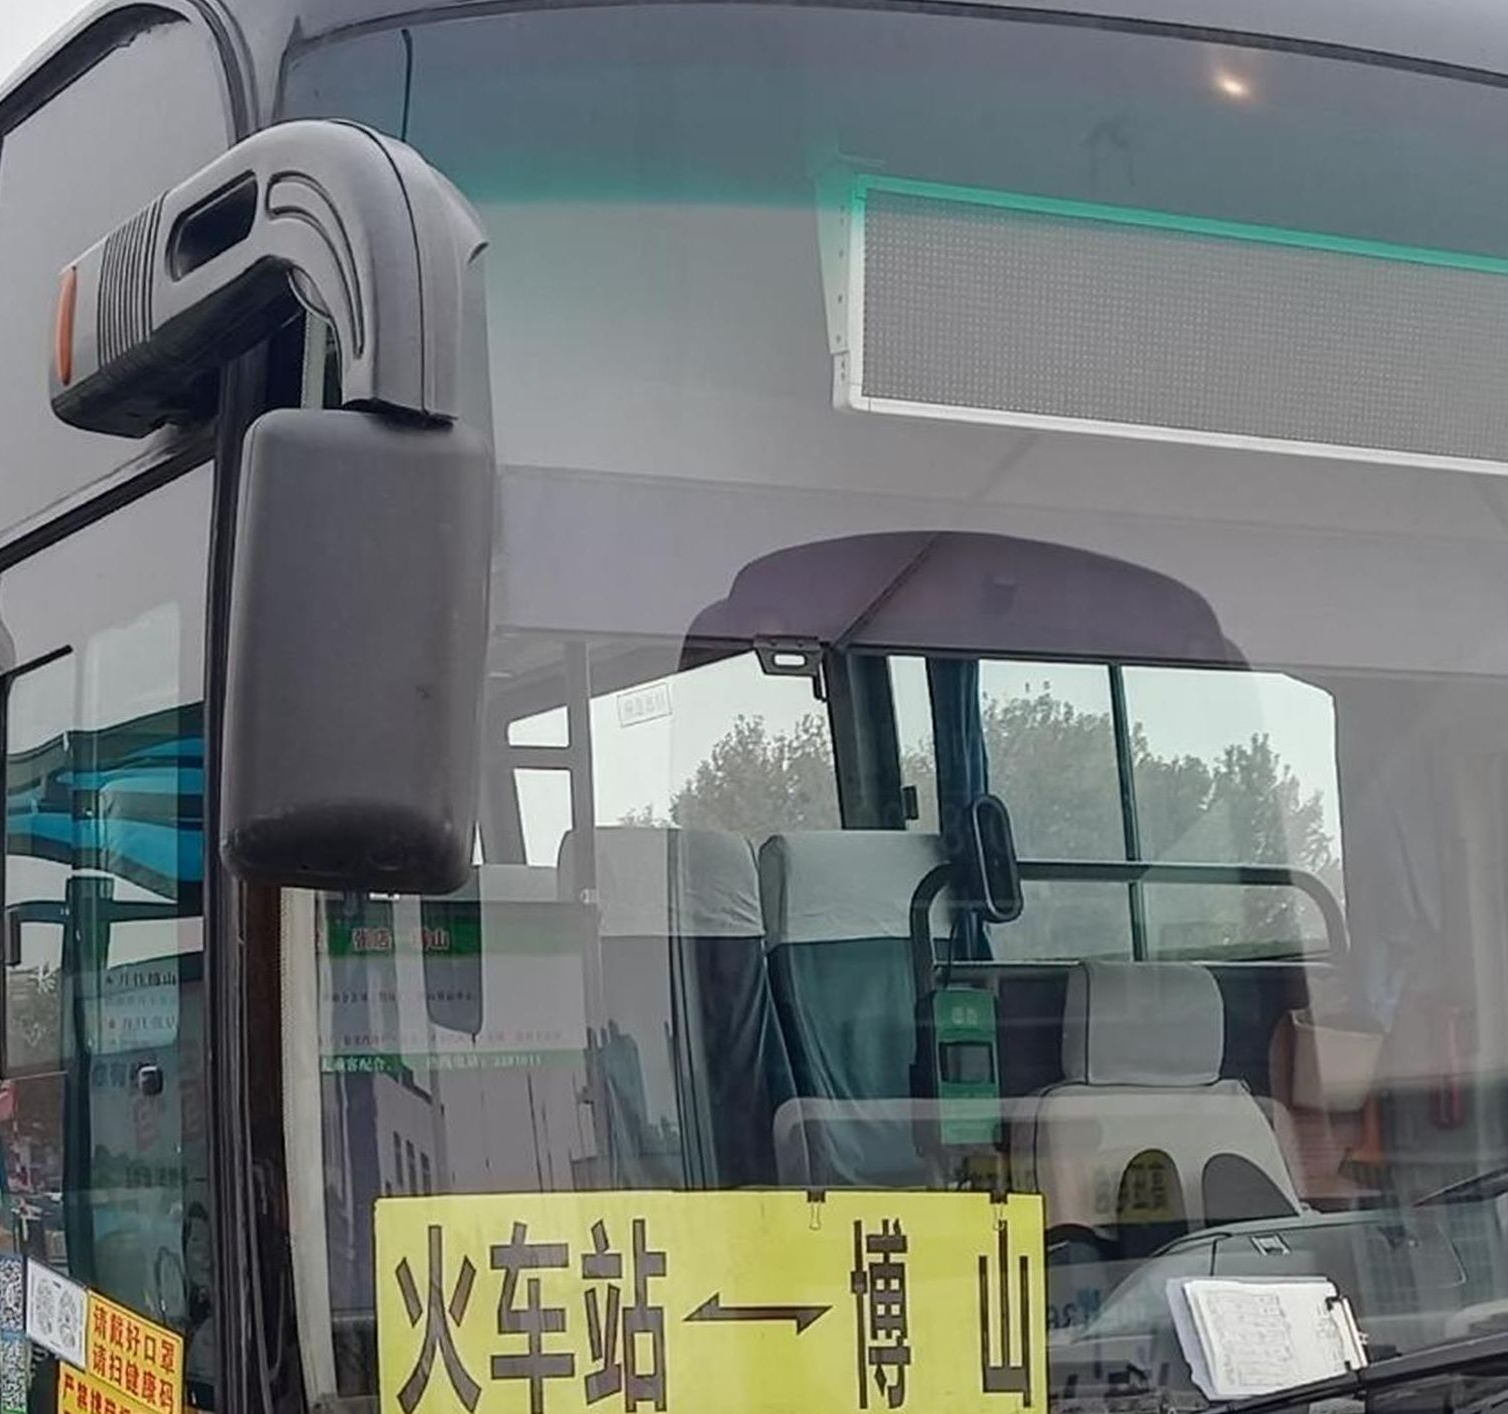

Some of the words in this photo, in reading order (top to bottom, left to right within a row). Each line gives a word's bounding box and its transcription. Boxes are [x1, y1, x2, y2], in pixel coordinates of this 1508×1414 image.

[92, 1304, 176, 1376] 请戴好口罩
[849, 1216, 1032, 1409] 博山
